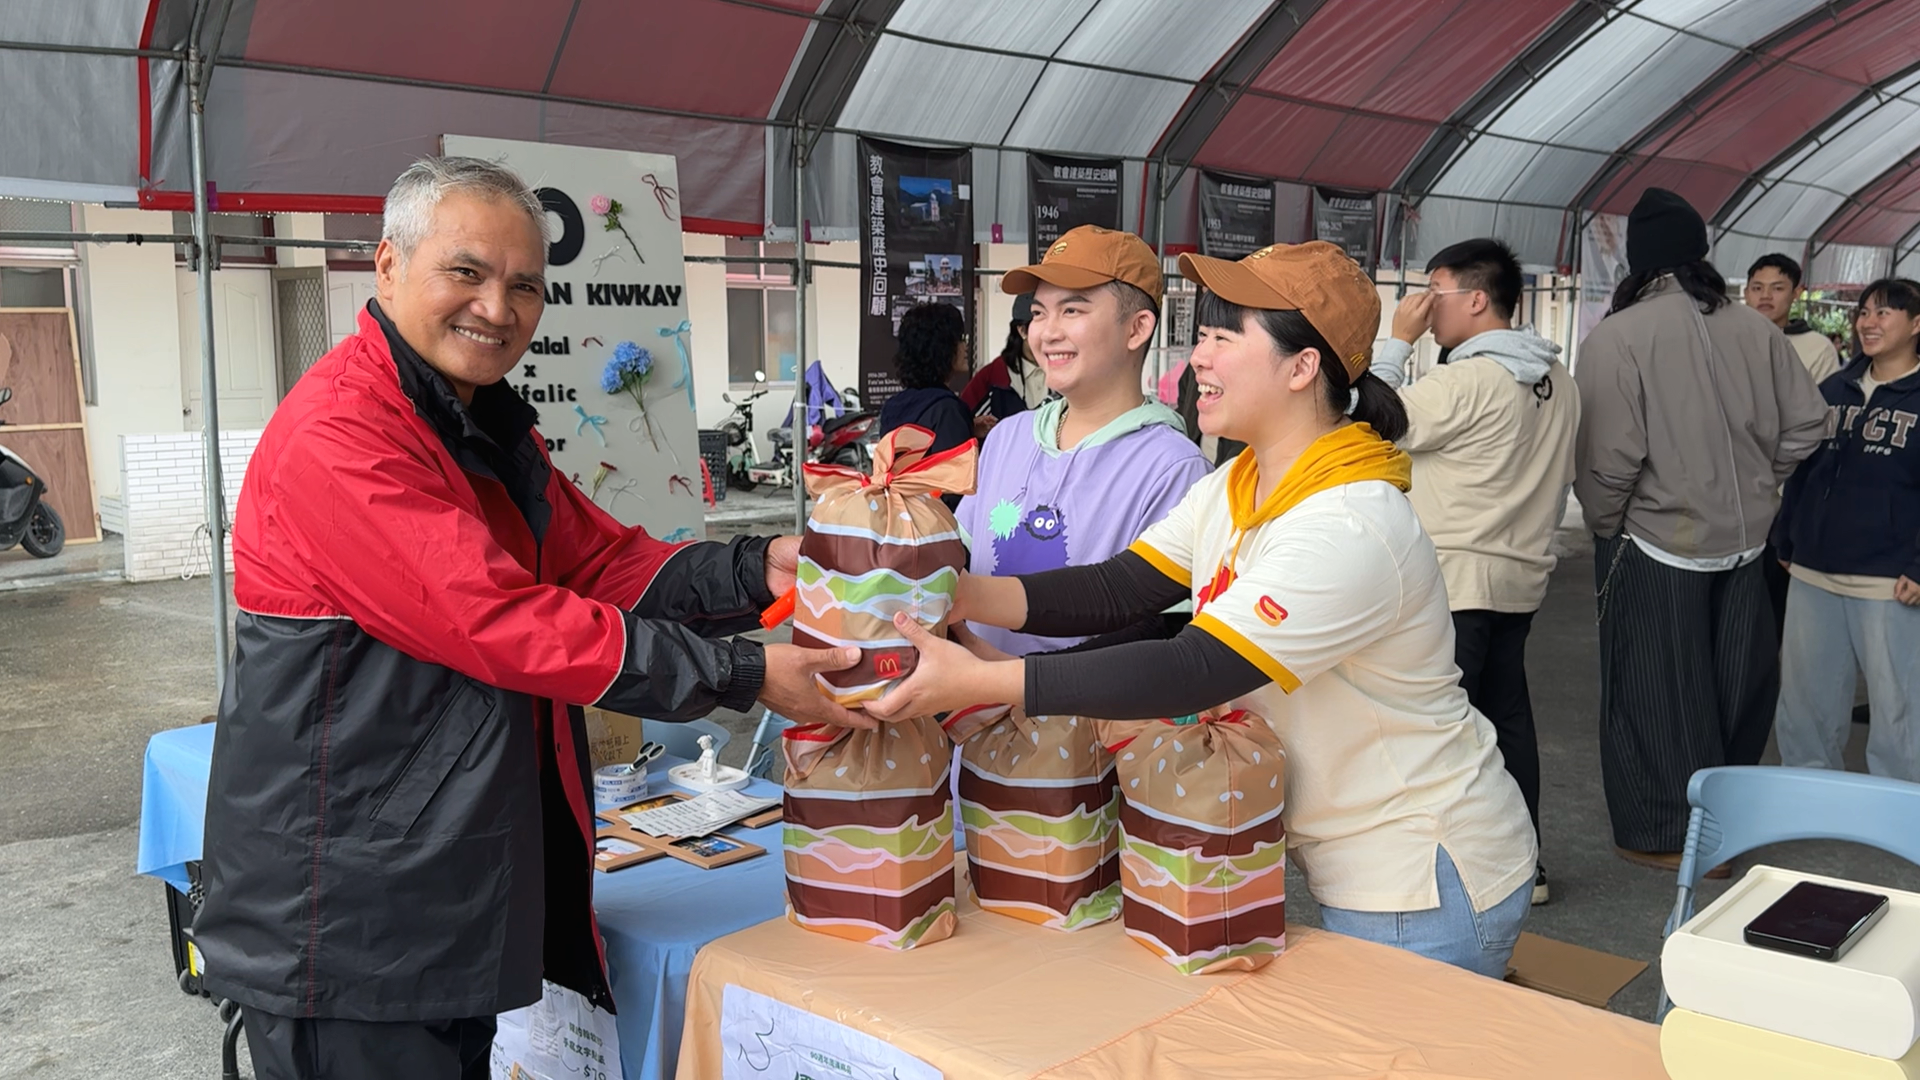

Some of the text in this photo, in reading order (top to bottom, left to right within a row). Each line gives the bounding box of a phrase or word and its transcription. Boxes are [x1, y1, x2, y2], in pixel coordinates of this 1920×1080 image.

[1037, 205, 1060, 219] 1946
[869, 154, 888, 316] 教會建築歷史回顧
[586, 283, 682, 307] KIWKAY
[528, 336, 571, 355] alal
